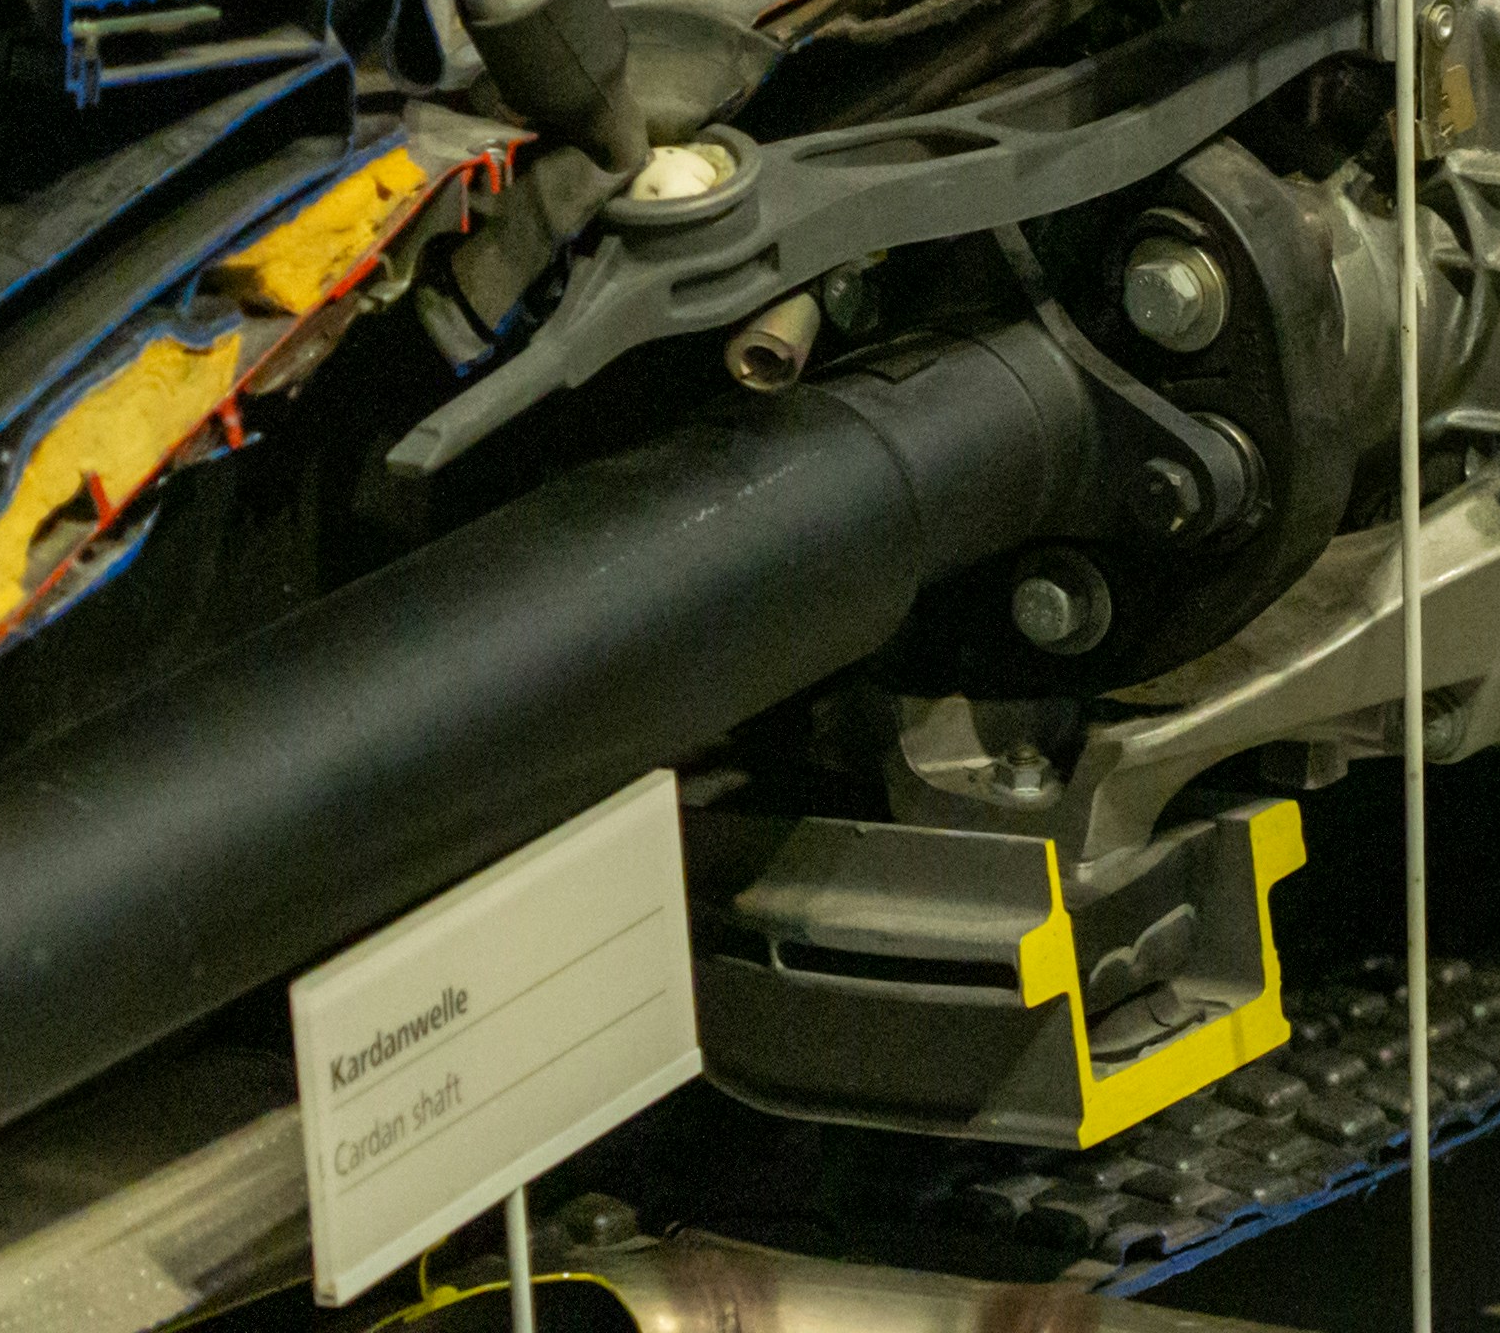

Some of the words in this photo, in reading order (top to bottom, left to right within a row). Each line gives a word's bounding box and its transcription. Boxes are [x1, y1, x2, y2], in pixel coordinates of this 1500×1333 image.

[328, 985, 469, 1093] Kardanwelle
[333, 1109, 405, 1178] Cardan
[411, 1071, 463, 1135] shaft
